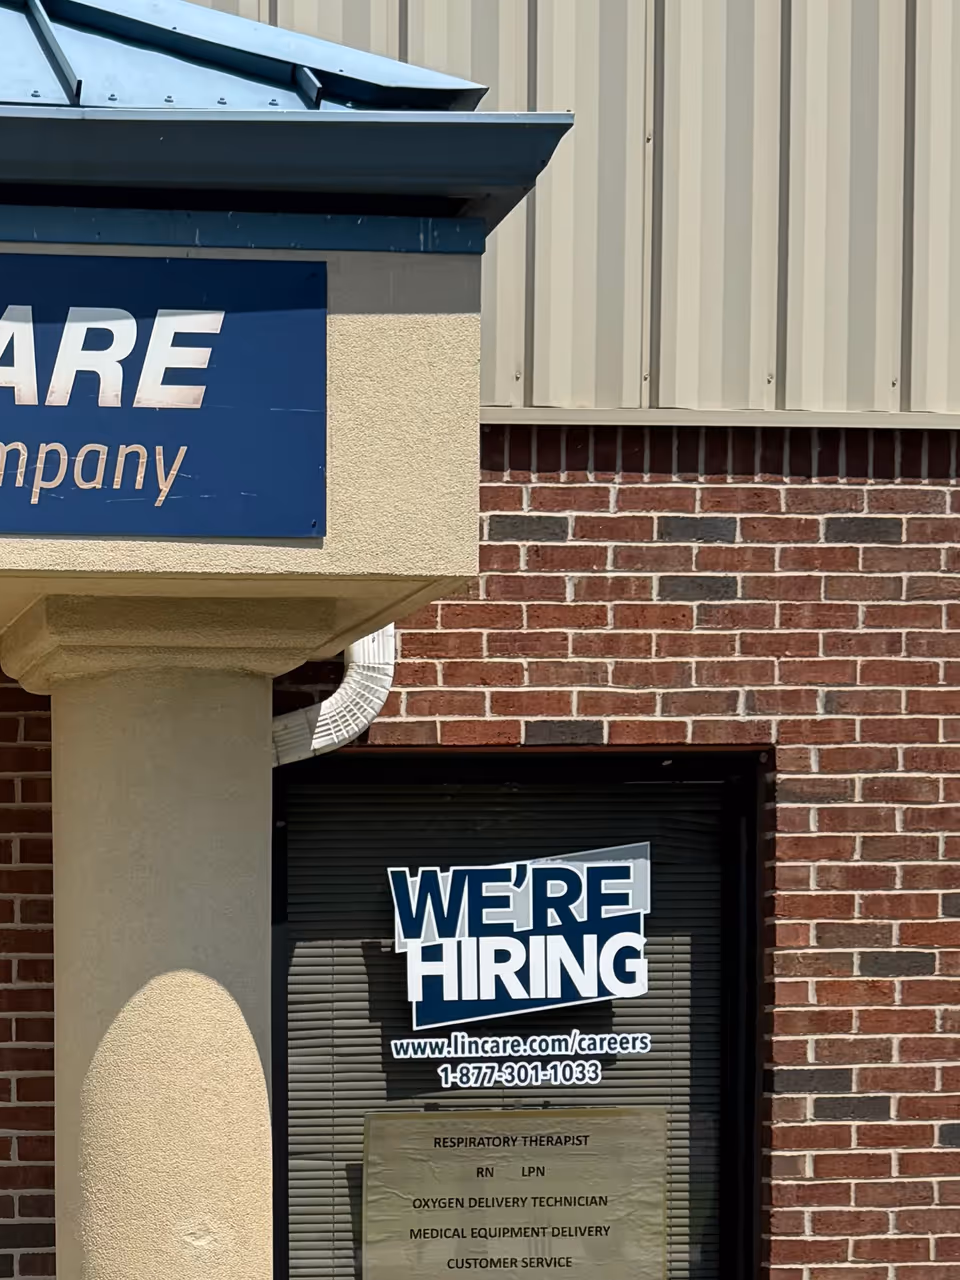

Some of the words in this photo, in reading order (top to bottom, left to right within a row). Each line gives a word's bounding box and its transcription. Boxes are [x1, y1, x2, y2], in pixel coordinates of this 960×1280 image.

[387, 862, 634, 942] WE'RE
[406, 931, 649, 1003] HIRING
[390, 1029, 652, 1059] www.lincare.com/careers
[437, 1060, 602, 1088] 1-877-301-1033
[433, 1135, 519, 1149] RESPIRATORY
[521, 1134, 590, 1147] THERAPIST
[476, 1166, 495, 1178] RN
[521, 1165, 546, 1177] LPN
[412, 1197, 465, 1209] OXYGEN
[467, 1196, 528, 1208] DELIVERY
[530, 1195, 609, 1208] TECHNICIAN
[409, 1227, 467, 1240] MEDICAL
[470, 1226, 549, 1240] EQUIPMENT
[551, 1225, 611, 1237] DELIVERY
[446, 1258, 518, 1269] CUSTOMER
[520, 1256, 573, 1268] SERVICE
